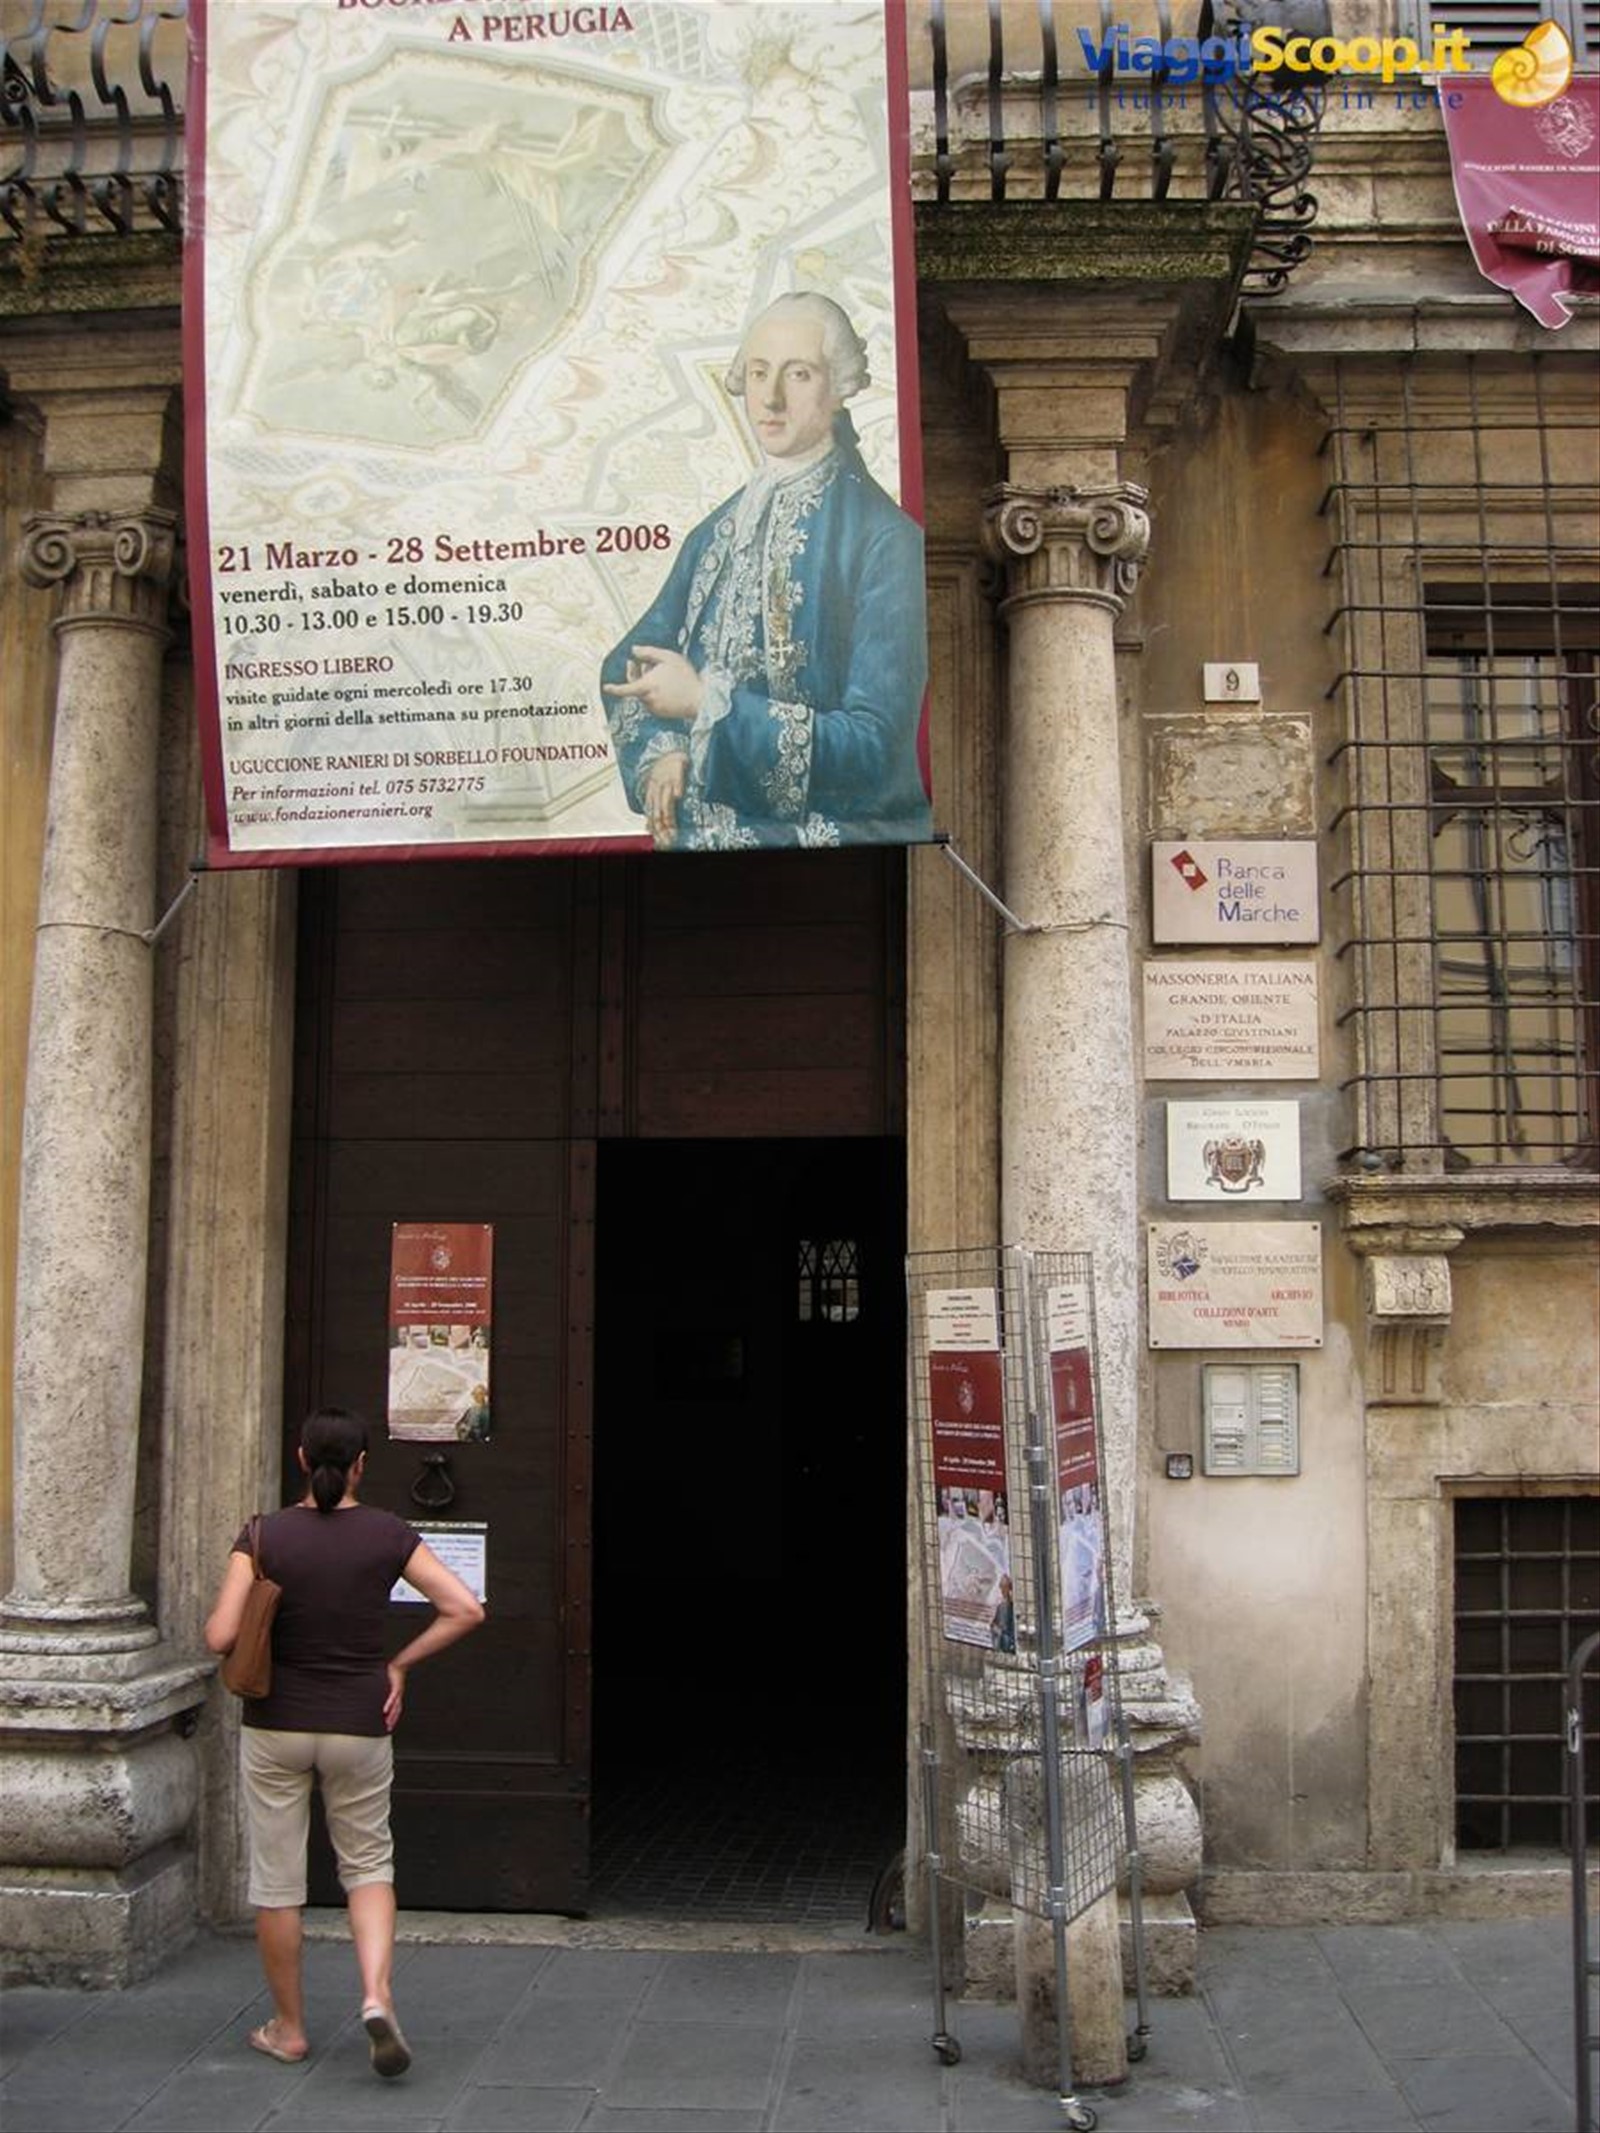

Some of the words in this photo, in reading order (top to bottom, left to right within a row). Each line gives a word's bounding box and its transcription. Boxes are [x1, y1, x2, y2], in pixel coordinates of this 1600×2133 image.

[448, 17, 472, 42] A
[482, 7, 634, 42] PERUGIA
[217, 545, 252, 573] 21
[265, 541, 359, 571] Marzo
[386, 537, 425, 564] 28
[434, 530, 586, 564] Settembre
[595, 524, 672, 554] 2008
[219, 577, 304, 604] venerdì,
[310, 574, 379, 599] sabato
[384, 581, 398, 596] e
[402, 573, 507, 596] domenica
[223, 612, 281, 636] 10.30
[301, 608, 359, 632] 13.00
[365, 615, 378, 629] e
[386, 605, 445, 627] 15.00
[466, 602, 524, 624] 19.30
[225, 660, 319, 680] INGRESSO
[323, 656, 394, 675] LIBERO
[1225, 669, 1241, 692] 9
[226, 688, 267, 706] visite
[271, 684, 330, 706] guidate
[333, 683, 370, 704] ogni
[457, 683, 484, 697] ore
[490, 676, 534, 694] 17.30
[227, 716, 244, 732] in
[247, 714, 280, 731] altri
[284, 712, 331, 733] giorni
[334, 710, 374, 727] della
[378, 706, 456, 725] settimana
[460, 709, 479, 722] su
[484, 702, 589, 727] prenotazione
[229, 757, 324, 776] UGUCCIONE
[326, 753, 390, 772] RANIERI
[393, 751, 410, 768] DI
[413, 748, 498, 768] SORBELLO
[501, 743, 609, 764] FOUNDATION
[232, 785, 257, 801] Per
[260, 781, 355, 801] informazioni
[385, 778, 414, 795] 075
[418, 776, 486, 794] 5732775
[233, 801, 434, 824] www.fondazioneranieri.org
[1218, 881, 1266, 900] delle
[1218, 901, 1300, 923] Marche
[1146, 972, 1239, 986] MASSONERIA
[1243, 972, 1314, 986] ITALIANA
[1168, 994, 1228, 1006] GRANDE
[1231, 994, 1291, 1006] ORIENTE
